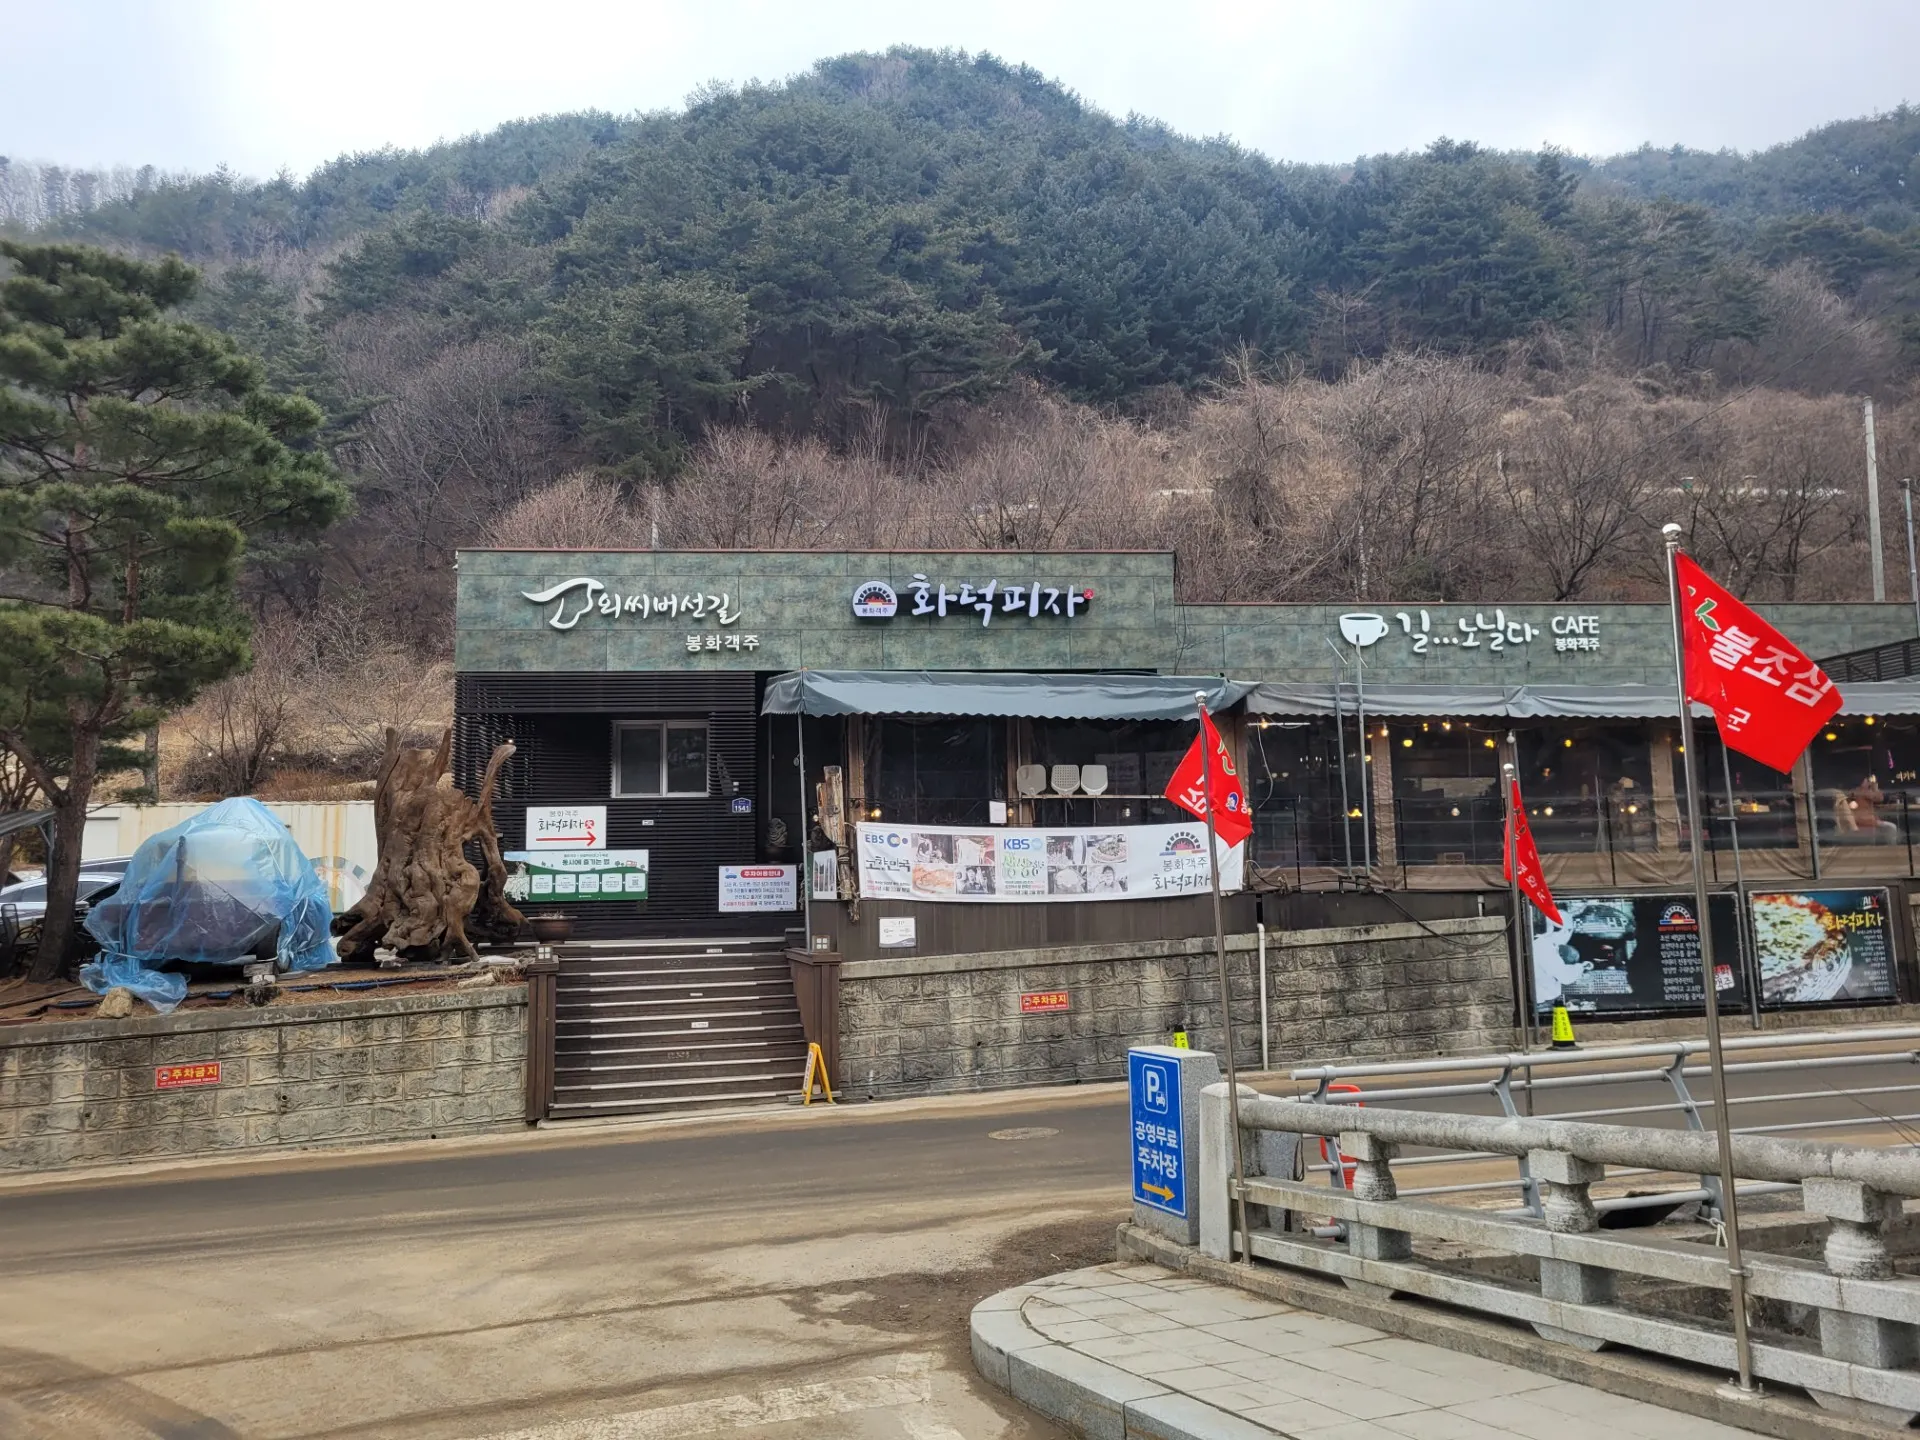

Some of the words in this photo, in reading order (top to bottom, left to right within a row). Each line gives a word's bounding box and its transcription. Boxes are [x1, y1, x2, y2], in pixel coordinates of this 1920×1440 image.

[598, 592, 741, 625] 외씨버선길
[907, 573, 1084, 628] 화덕피자
[1552, 615, 1600, 635] CAFE
[685, 634, 760, 652] 봉화객주
[1555, 637, 1600, 652] 봉화객주
[538, 818, 584, 832] 화덕피자
[865, 834, 884, 844] EBS
[1003, 838, 1030, 850] KBS
[1163, 856, 1208, 872] 봉화객주
[1152, 873, 1211, 892] 화덕피자
[1032, 994, 1066, 1005] 주차금지
[172, 1065, 217, 1079] 주차금지
[1145, 1070, 1160, 1103] P
[1135, 1121, 1178, 1149] 공영무료
[1137, 1146, 1178, 1180] 주차장
